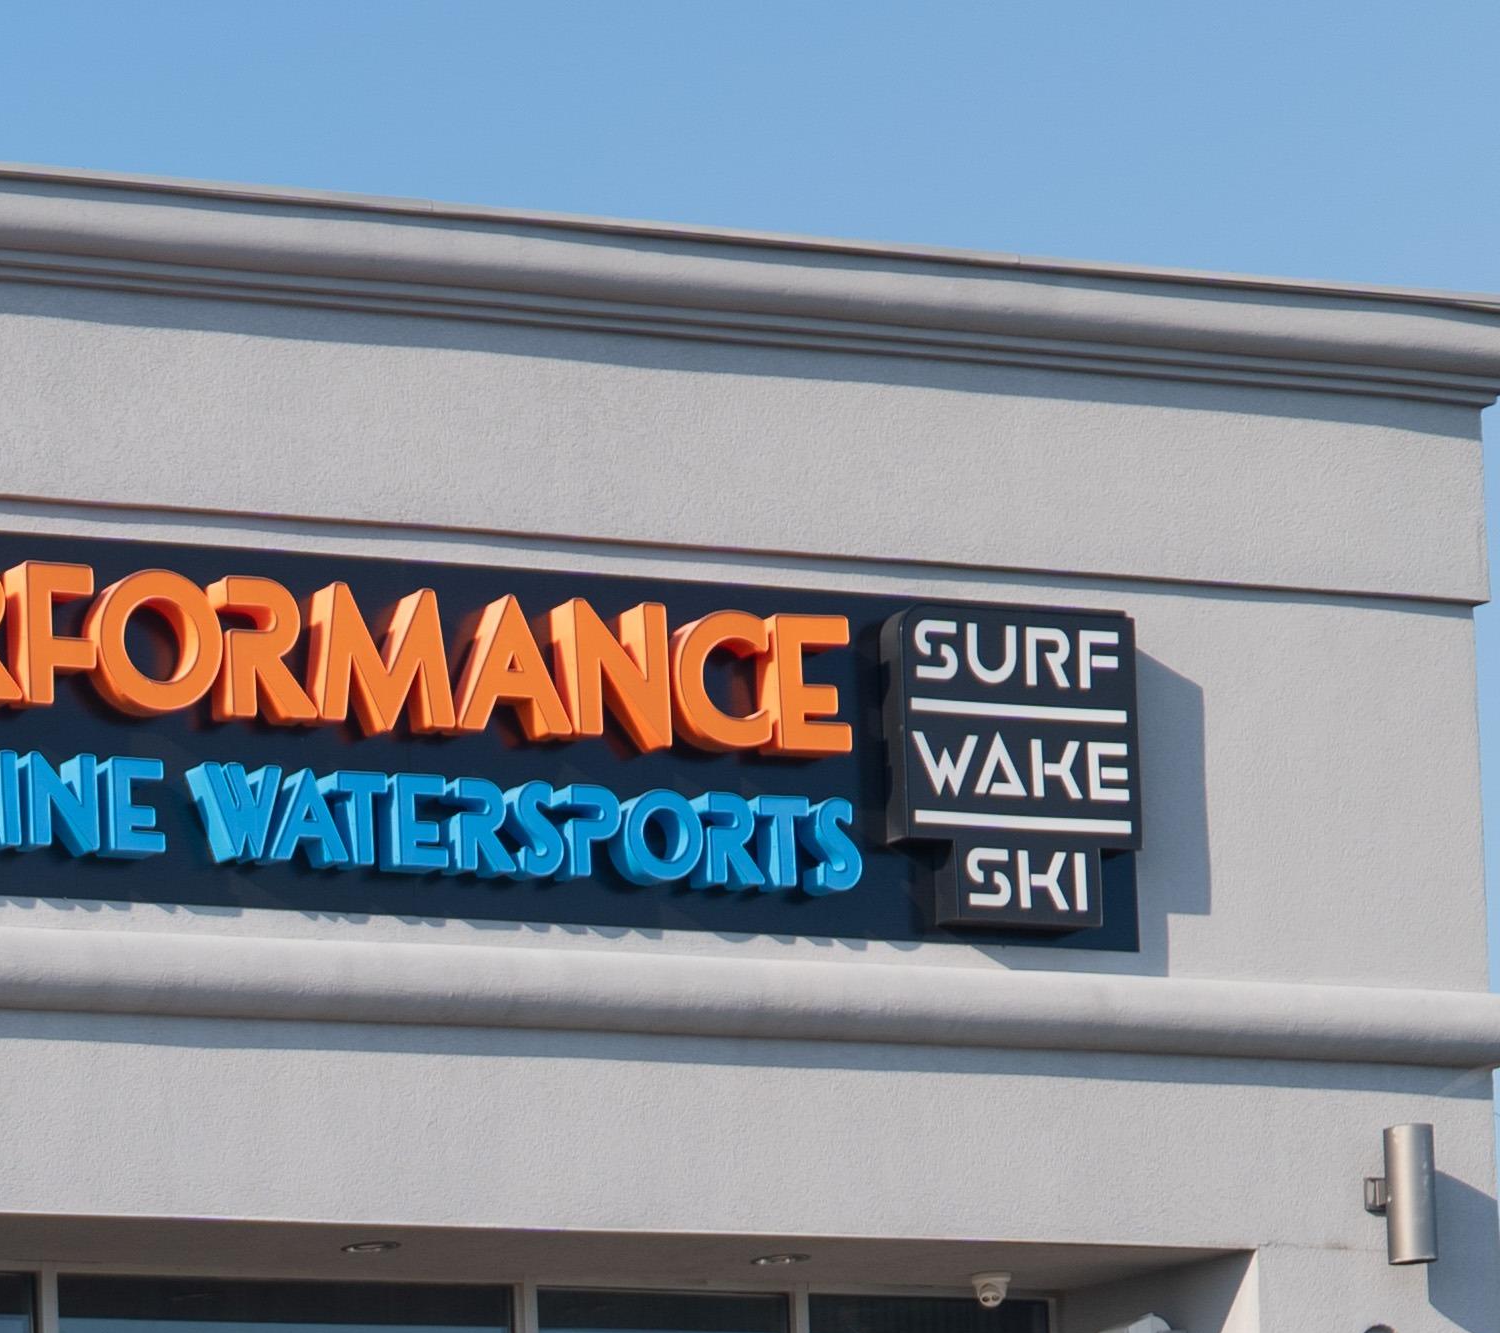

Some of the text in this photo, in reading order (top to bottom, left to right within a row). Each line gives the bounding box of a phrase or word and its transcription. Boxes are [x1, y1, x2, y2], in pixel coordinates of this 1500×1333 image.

[914, 619, 1119, 689] SURF
[911, 730, 1130, 801] WAKE
[185, 761, 863, 896] WATERSPORTS
[966, 847, 1088, 912] SKI
